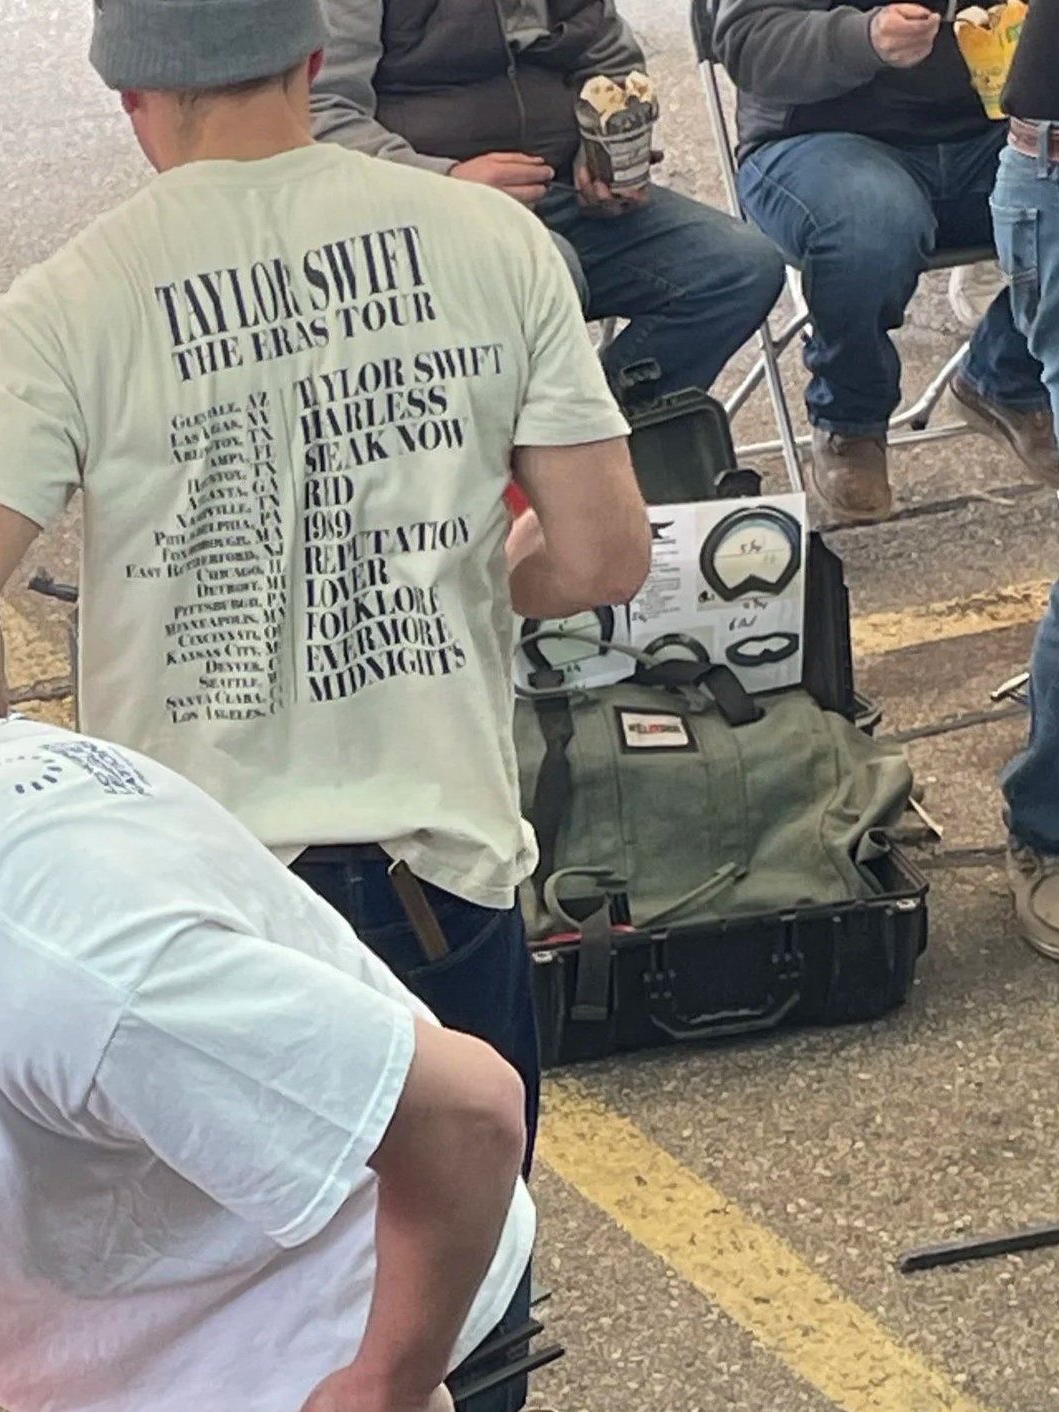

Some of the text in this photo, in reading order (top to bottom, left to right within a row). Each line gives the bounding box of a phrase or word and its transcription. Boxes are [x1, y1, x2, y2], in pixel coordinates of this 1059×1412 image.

[155, 225, 425, 346] TAYLOR SWIFT
[172, 292, 436, 382] THE ERAS TOUR
[293, 343, 503, 410] TYLOR SWIFT
[396, 417, 468, 455] NOW
[304, 509, 352, 542] 1989
[306, 557, 391, 608] LOVER
[306, 584, 441, 640] FOLKLORE
[306, 614, 454, 673] EVERMORE
[308, 643, 468, 701] MIDNIGHTS
